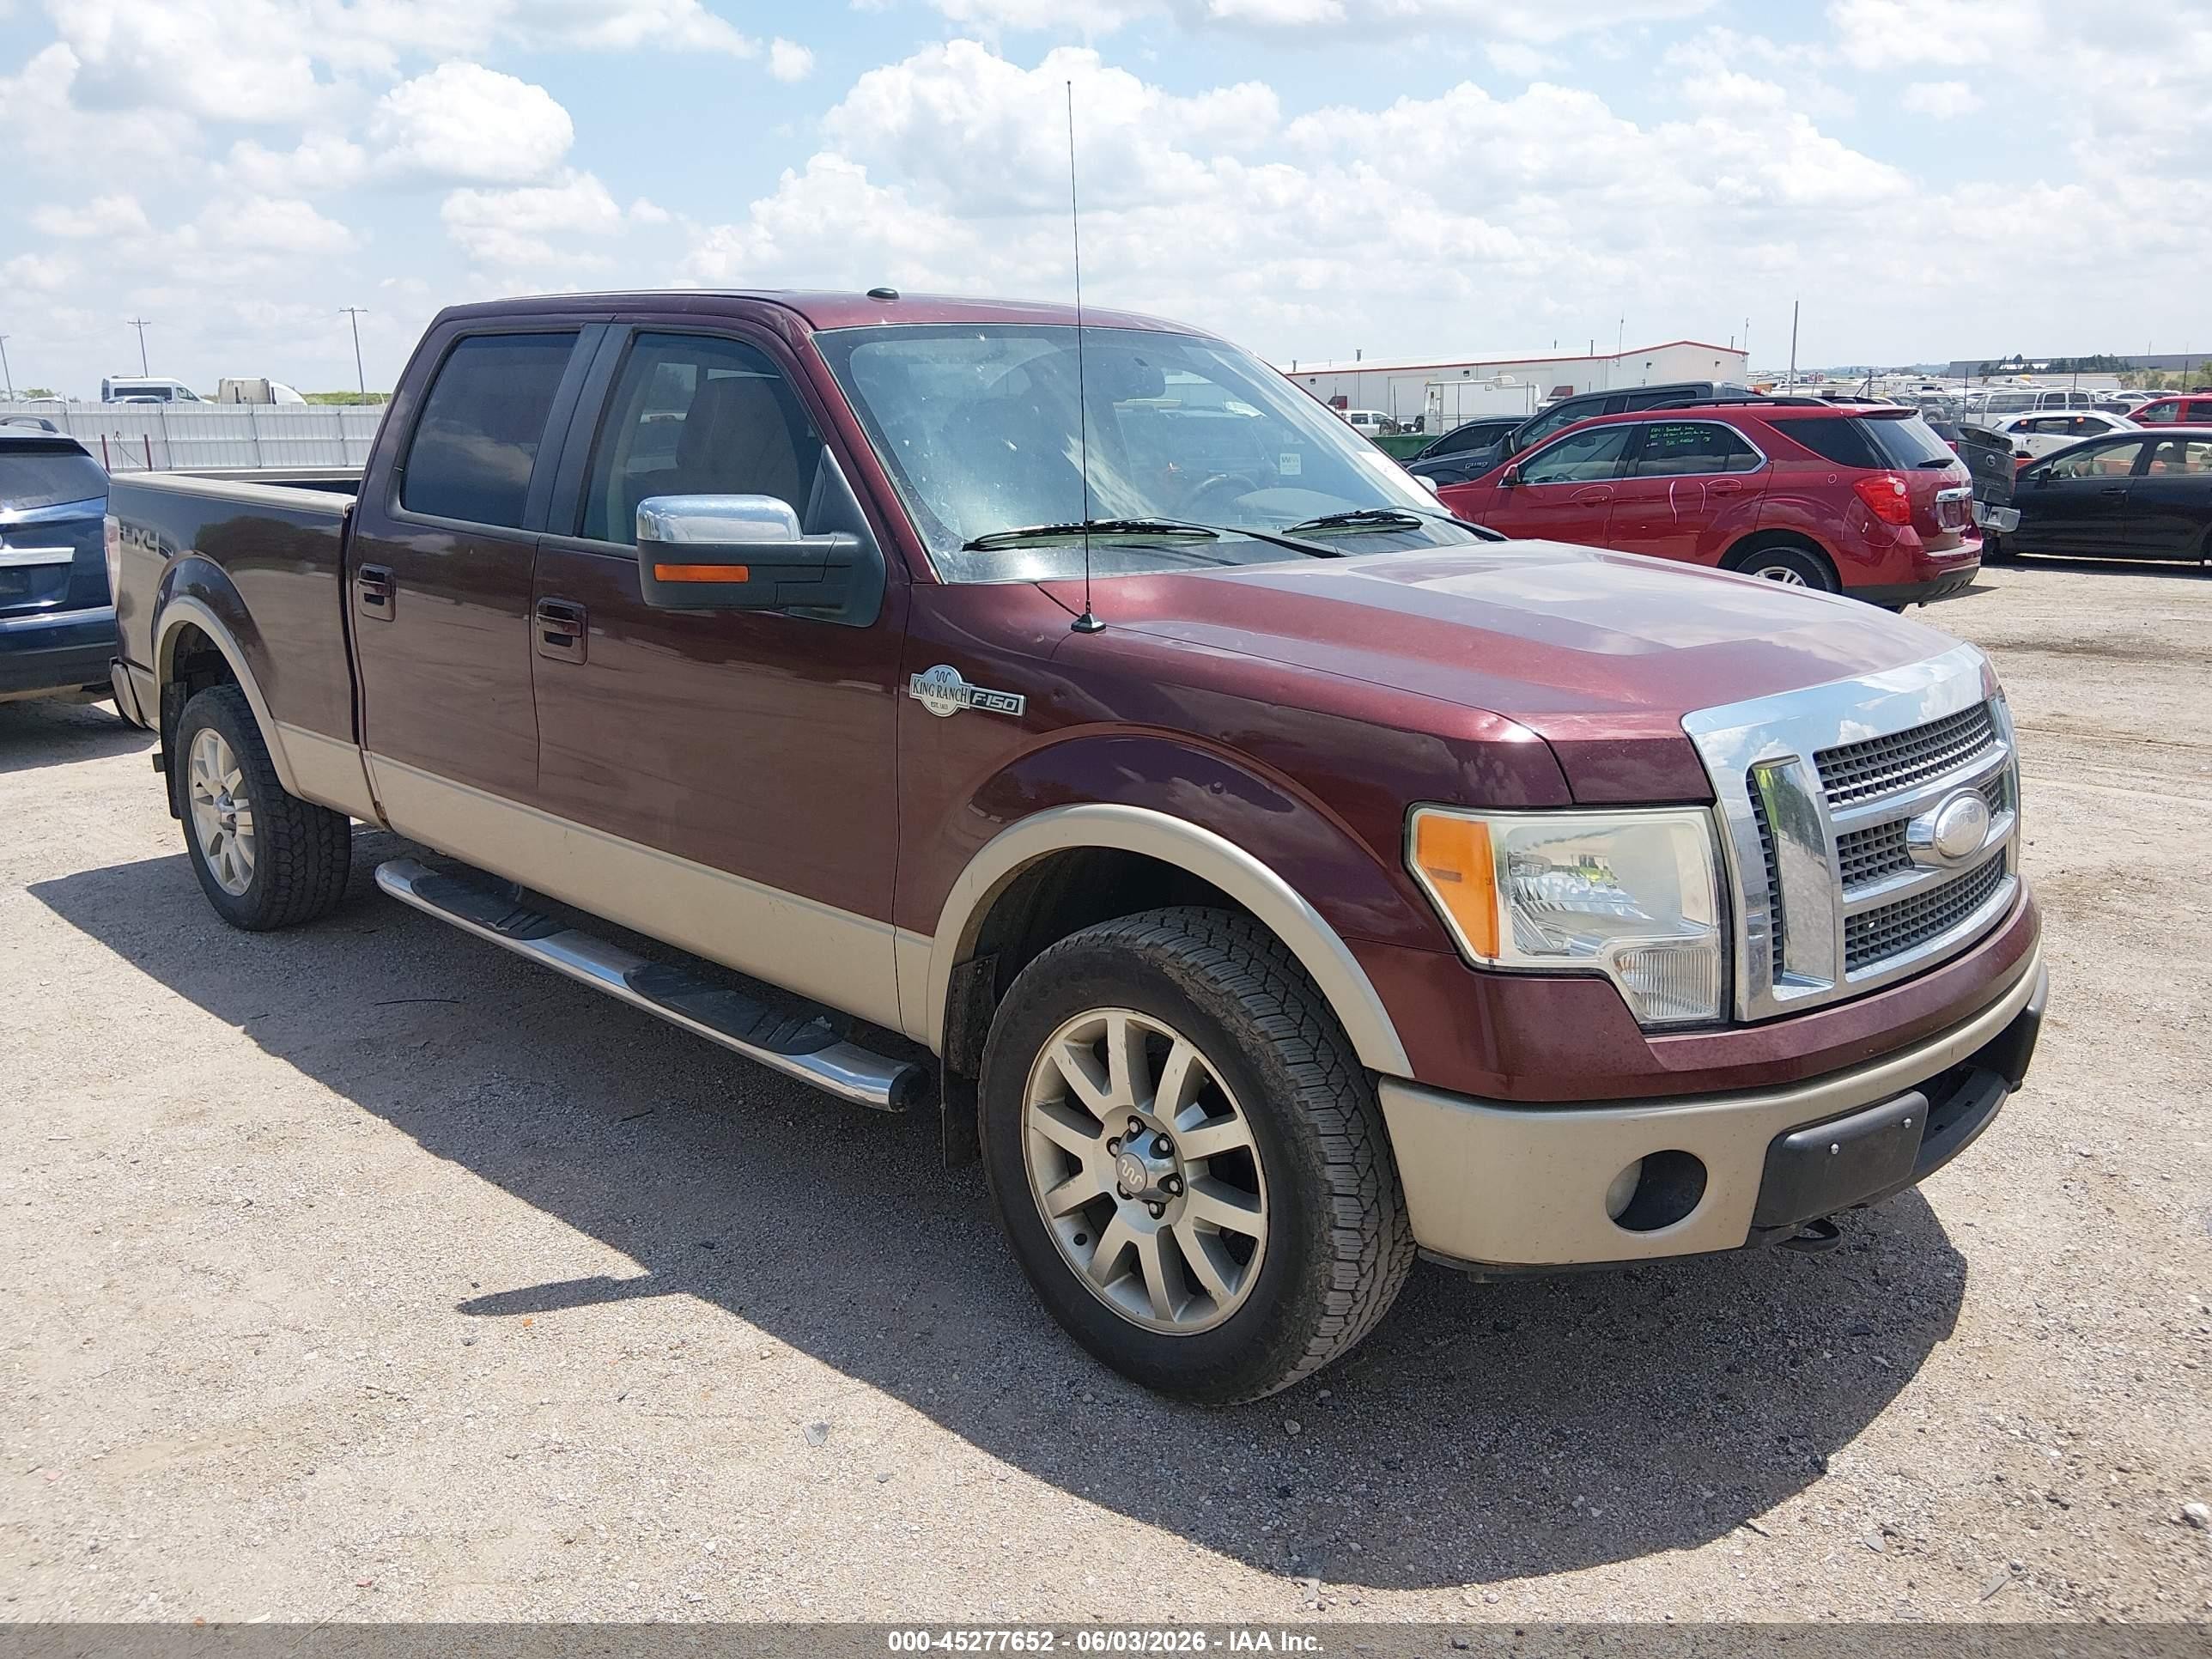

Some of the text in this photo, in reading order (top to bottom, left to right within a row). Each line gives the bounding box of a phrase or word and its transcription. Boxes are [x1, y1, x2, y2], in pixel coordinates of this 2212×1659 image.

[913, 679, 968, 703] KING RANCH
[972, 692, 1018, 711] F-150
